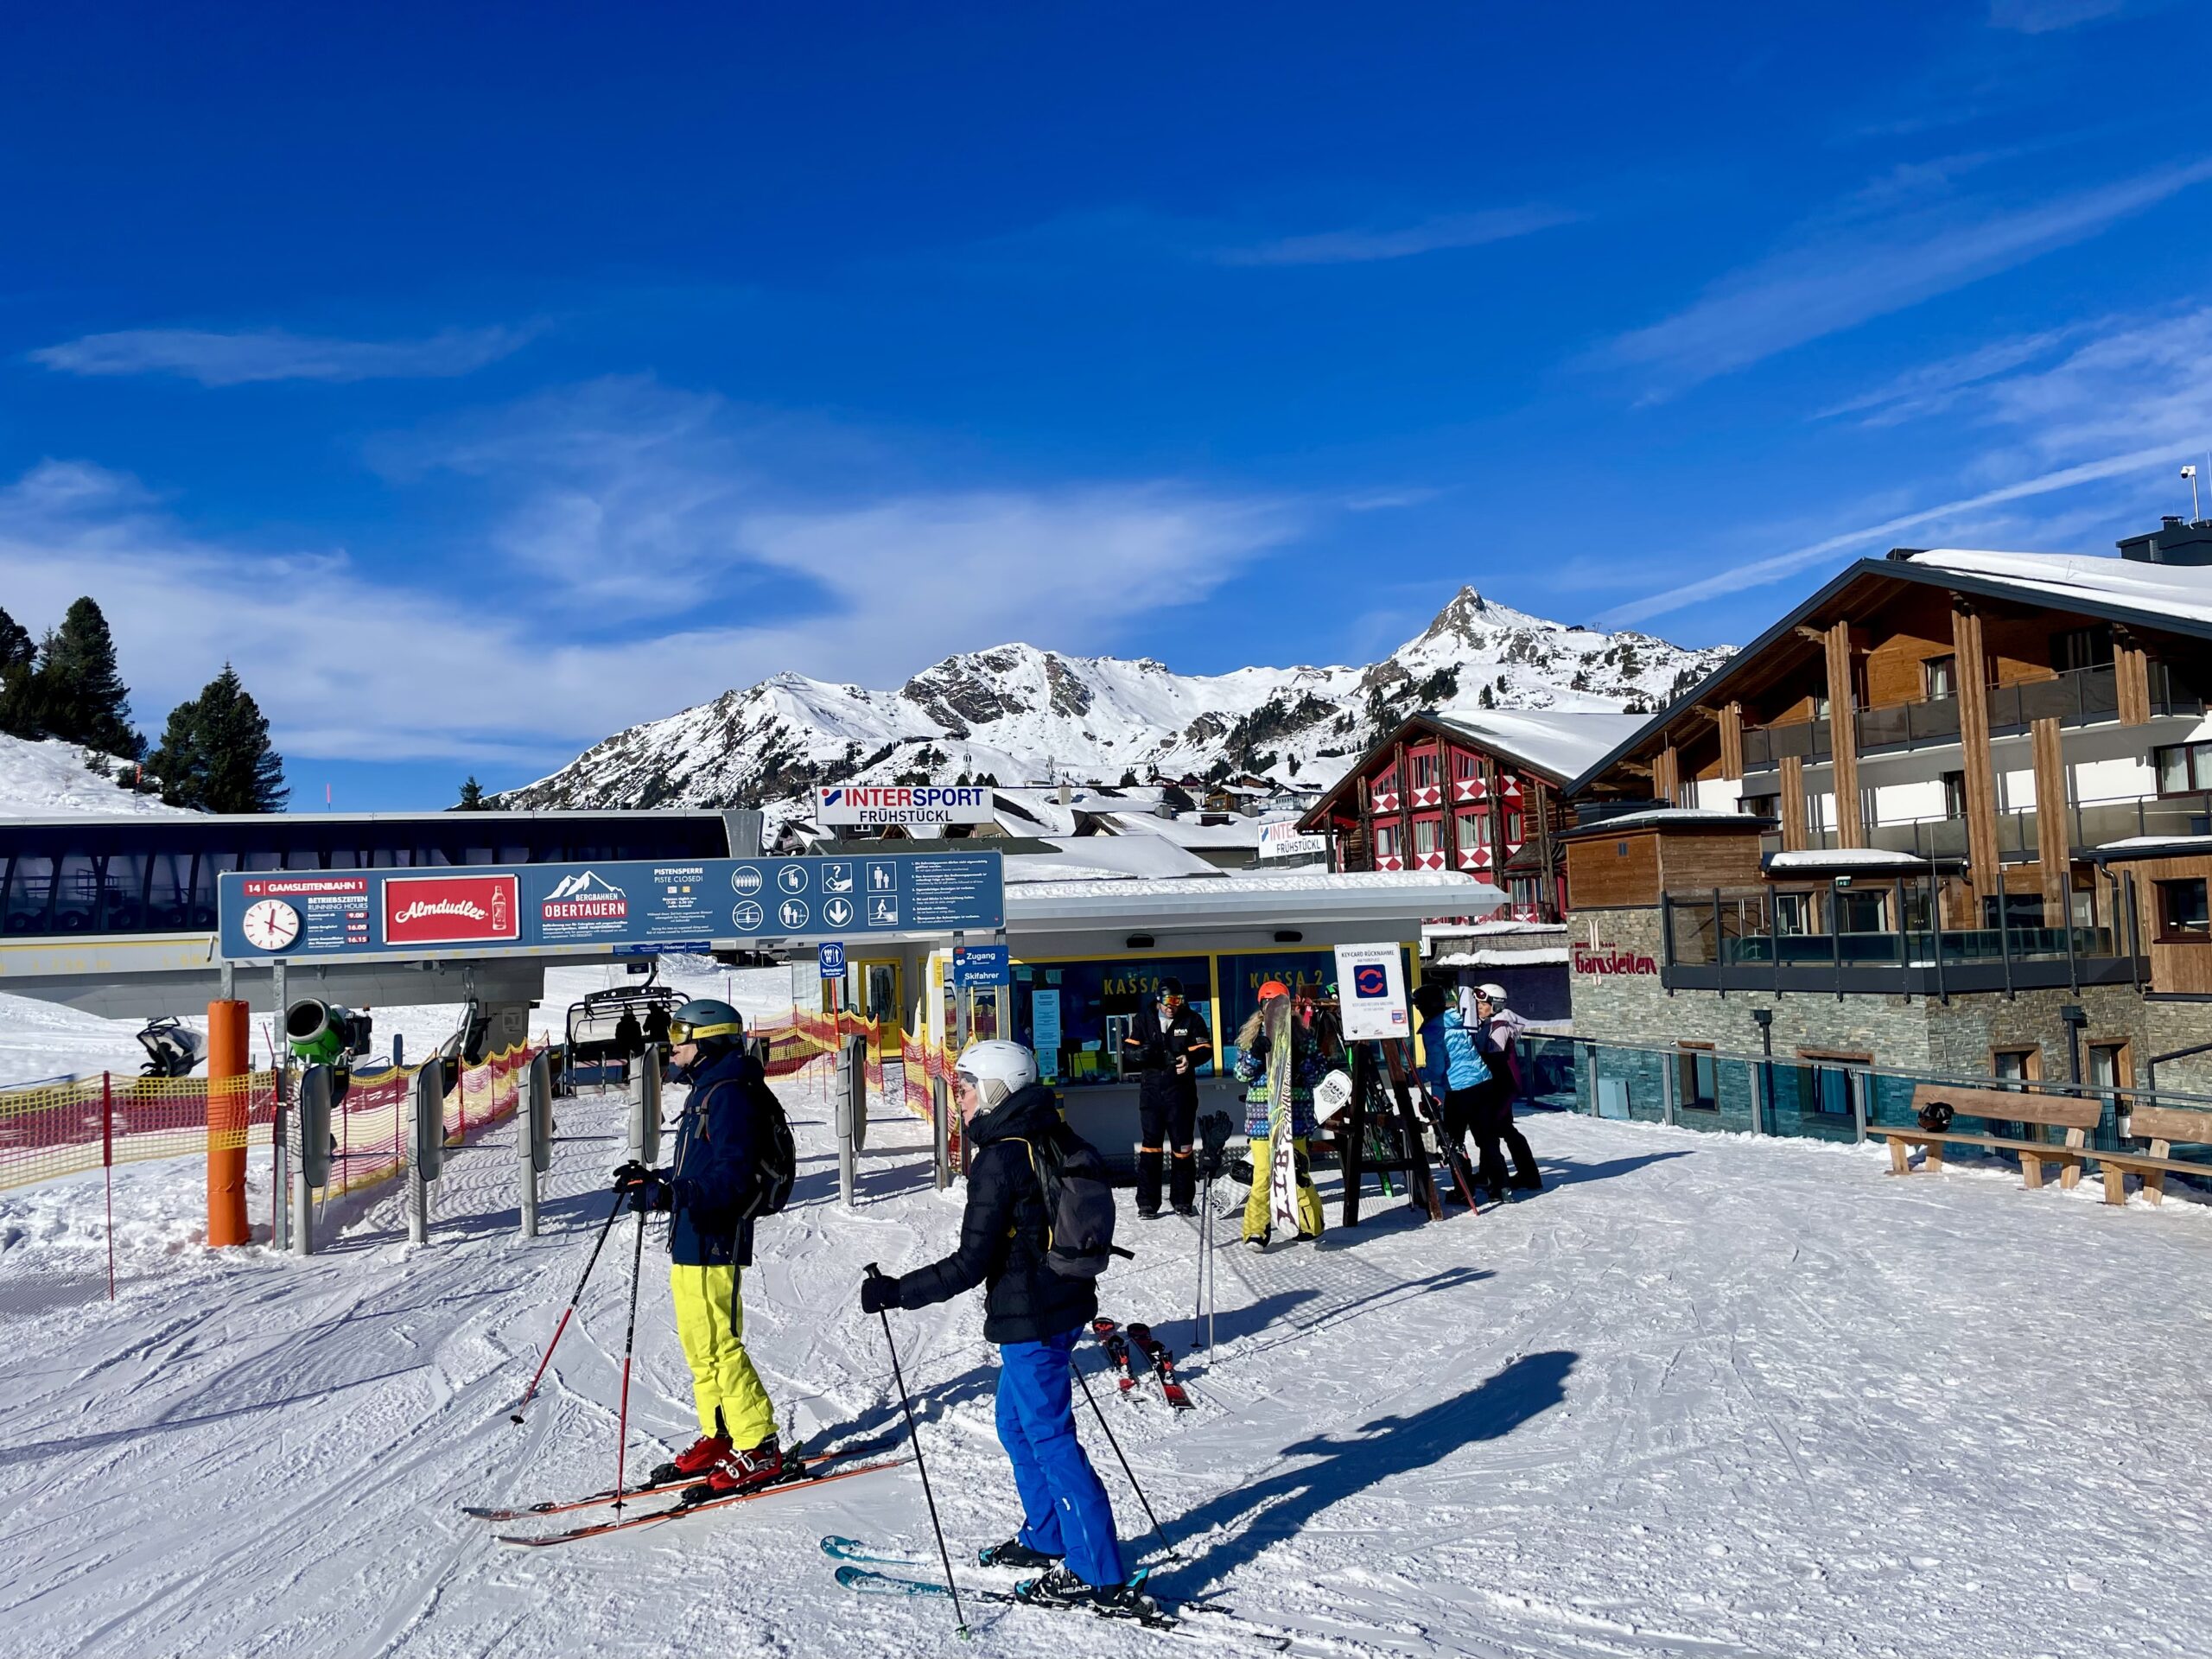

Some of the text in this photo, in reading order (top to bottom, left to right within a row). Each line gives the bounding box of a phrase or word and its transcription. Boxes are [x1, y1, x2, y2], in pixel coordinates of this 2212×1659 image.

[845, 788, 984, 807] INTERSPORT
[859, 808, 953, 823] FRÜHSTÜCKL
[1276, 838, 1320, 854] FRÜHSTÜCKL
[248, 884, 261, 893] 14
[268, 881, 355, 893] GAMSLEITENBAHN
[575, 893, 618, 902] BERGBAHNEN
[395, 899, 486, 924] Almdudler
[544, 903, 625, 918] OBERTAUERN
[1313, 969, 1324, 985] 2
[1103, 976, 1160, 995] KASSA
[1057, 1584, 1092, 1595] HEAD
